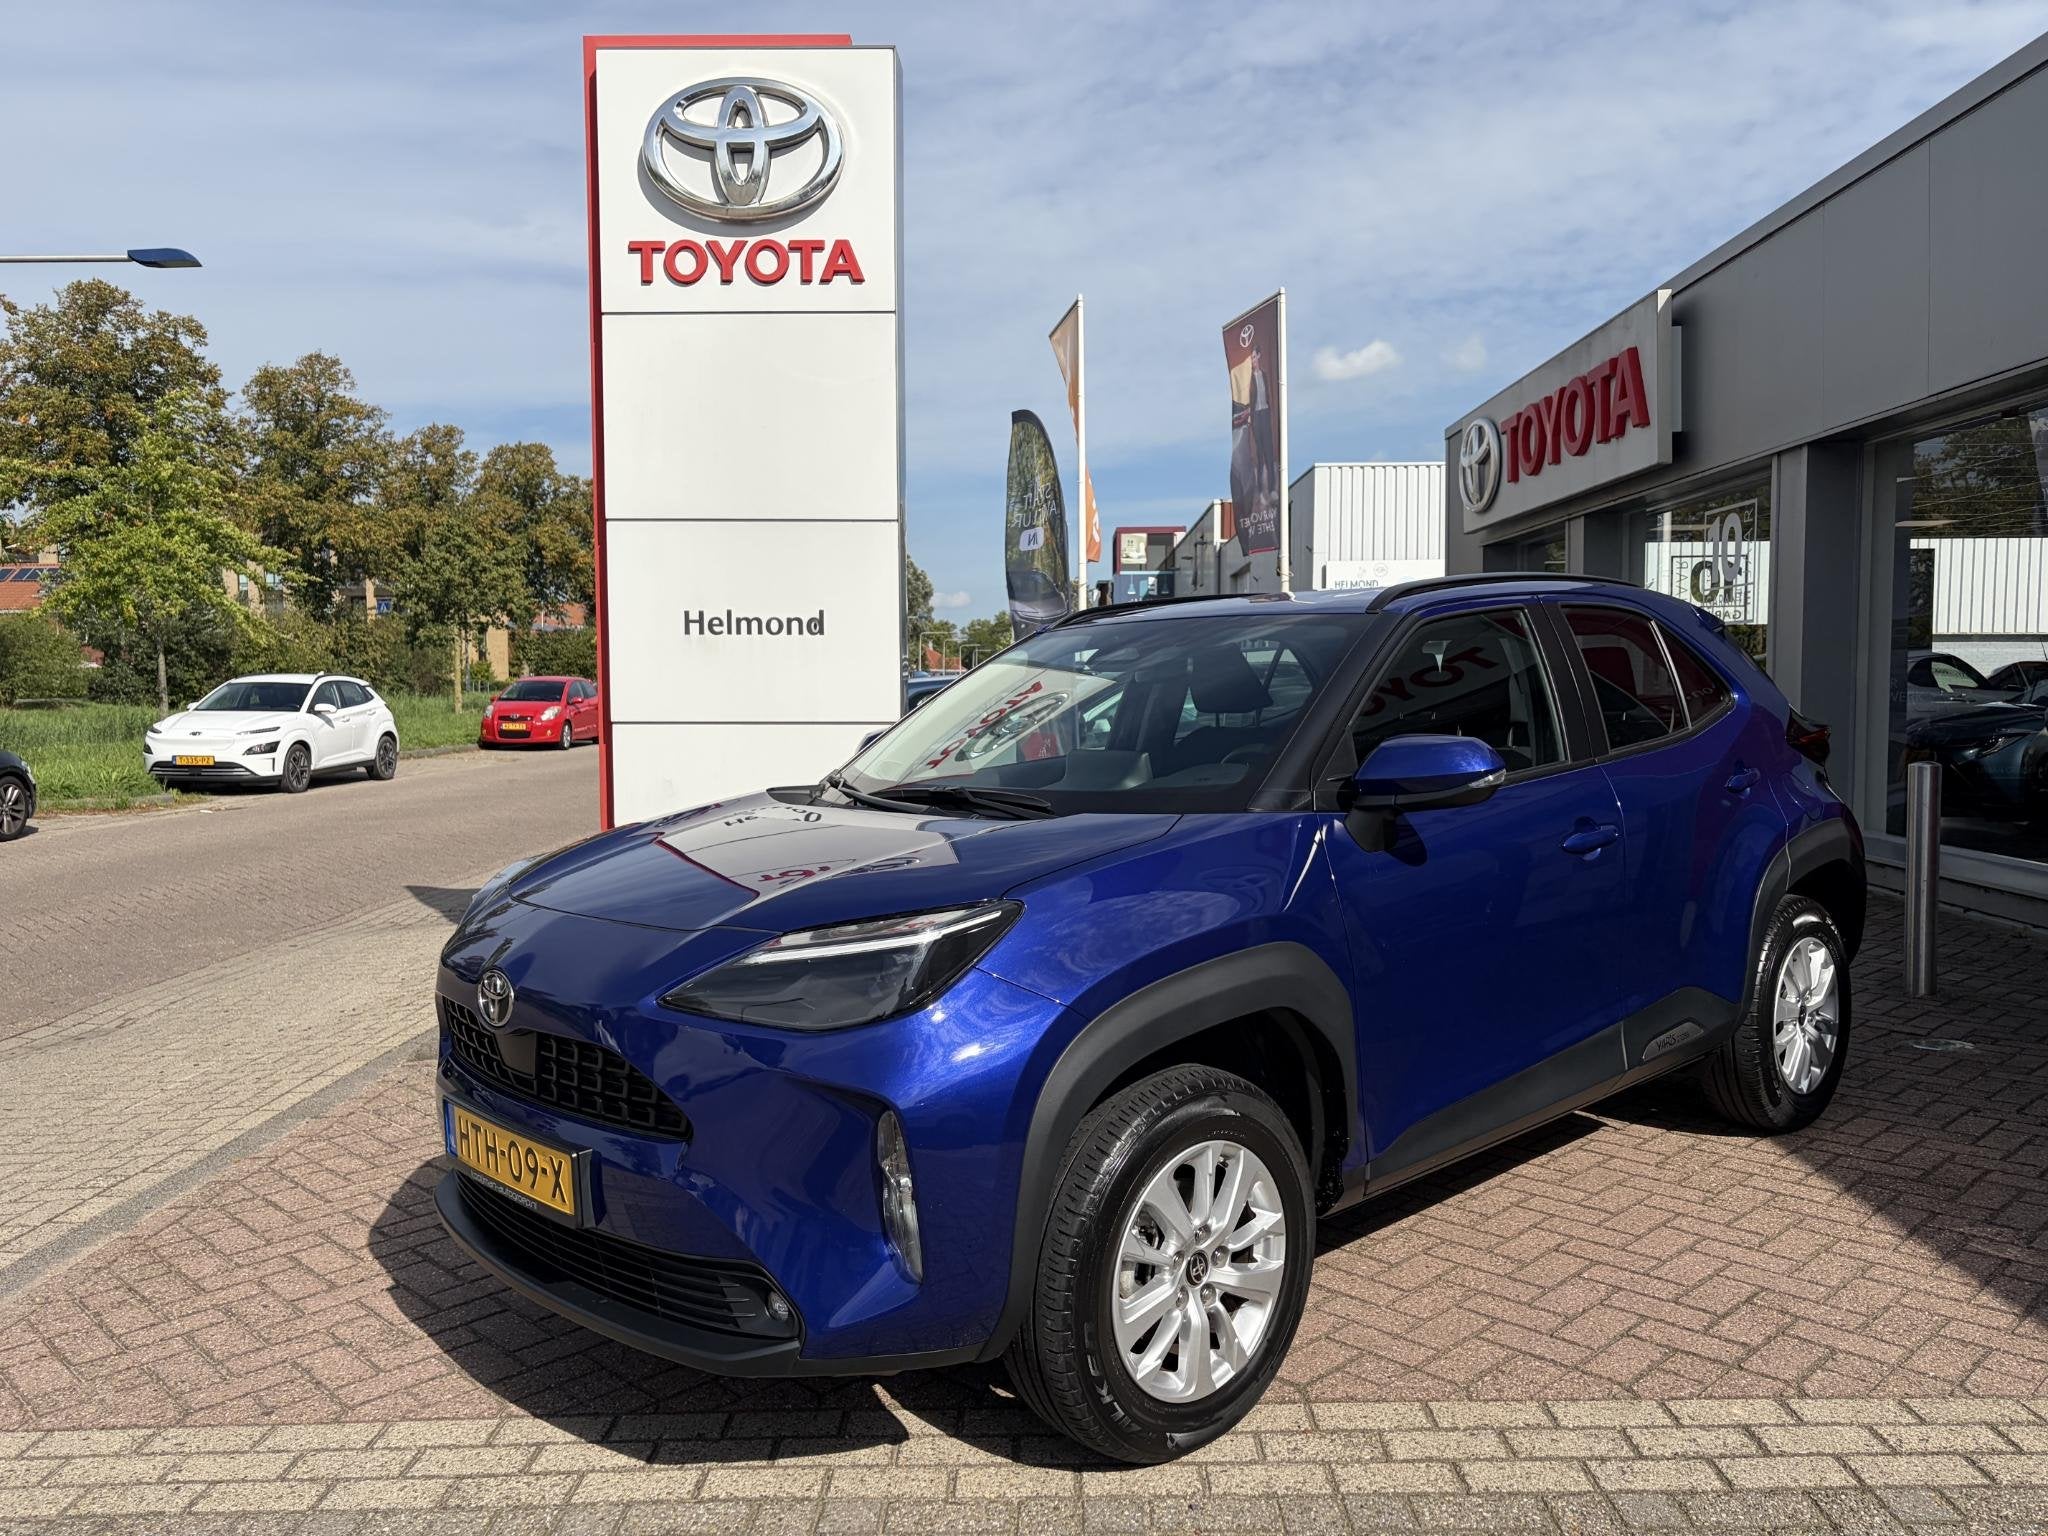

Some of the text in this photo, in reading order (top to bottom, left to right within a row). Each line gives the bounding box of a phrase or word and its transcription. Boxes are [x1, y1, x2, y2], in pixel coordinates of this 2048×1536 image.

[628, 239, 865, 285] TOYOTA
[1501, 346, 1651, 483] TOYOTA
[683, 609, 825, 636] Helmond
[458, 1115, 568, 1205] HTH-09-X
